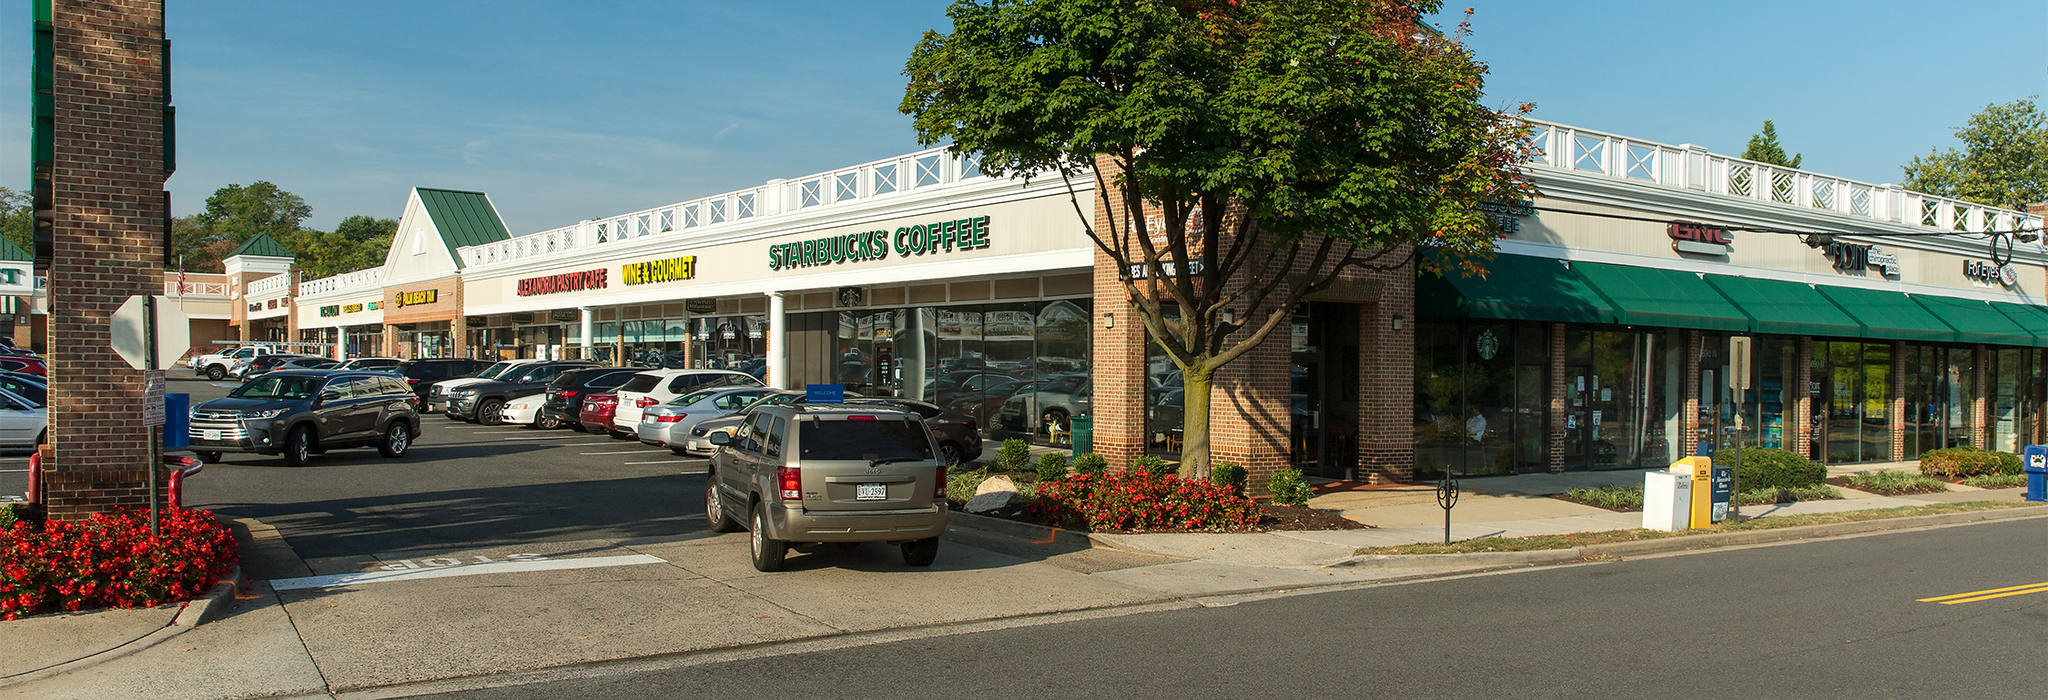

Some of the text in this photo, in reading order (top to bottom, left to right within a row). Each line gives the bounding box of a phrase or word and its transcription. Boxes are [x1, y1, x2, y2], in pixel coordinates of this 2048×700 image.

[769, 215, 990, 270] STARBUCKS COFFEE
[1672, 219, 1732, 243] GNC
[517, 267, 608, 296] ALEXANDRIA PASTRY CAFE
[622, 255, 697, 285] WINE & GOURMET
[1968, 263, 1981, 276] For
[1981, 265, 2000, 280] Eyes
[380, 553, 549, 571] STOP
